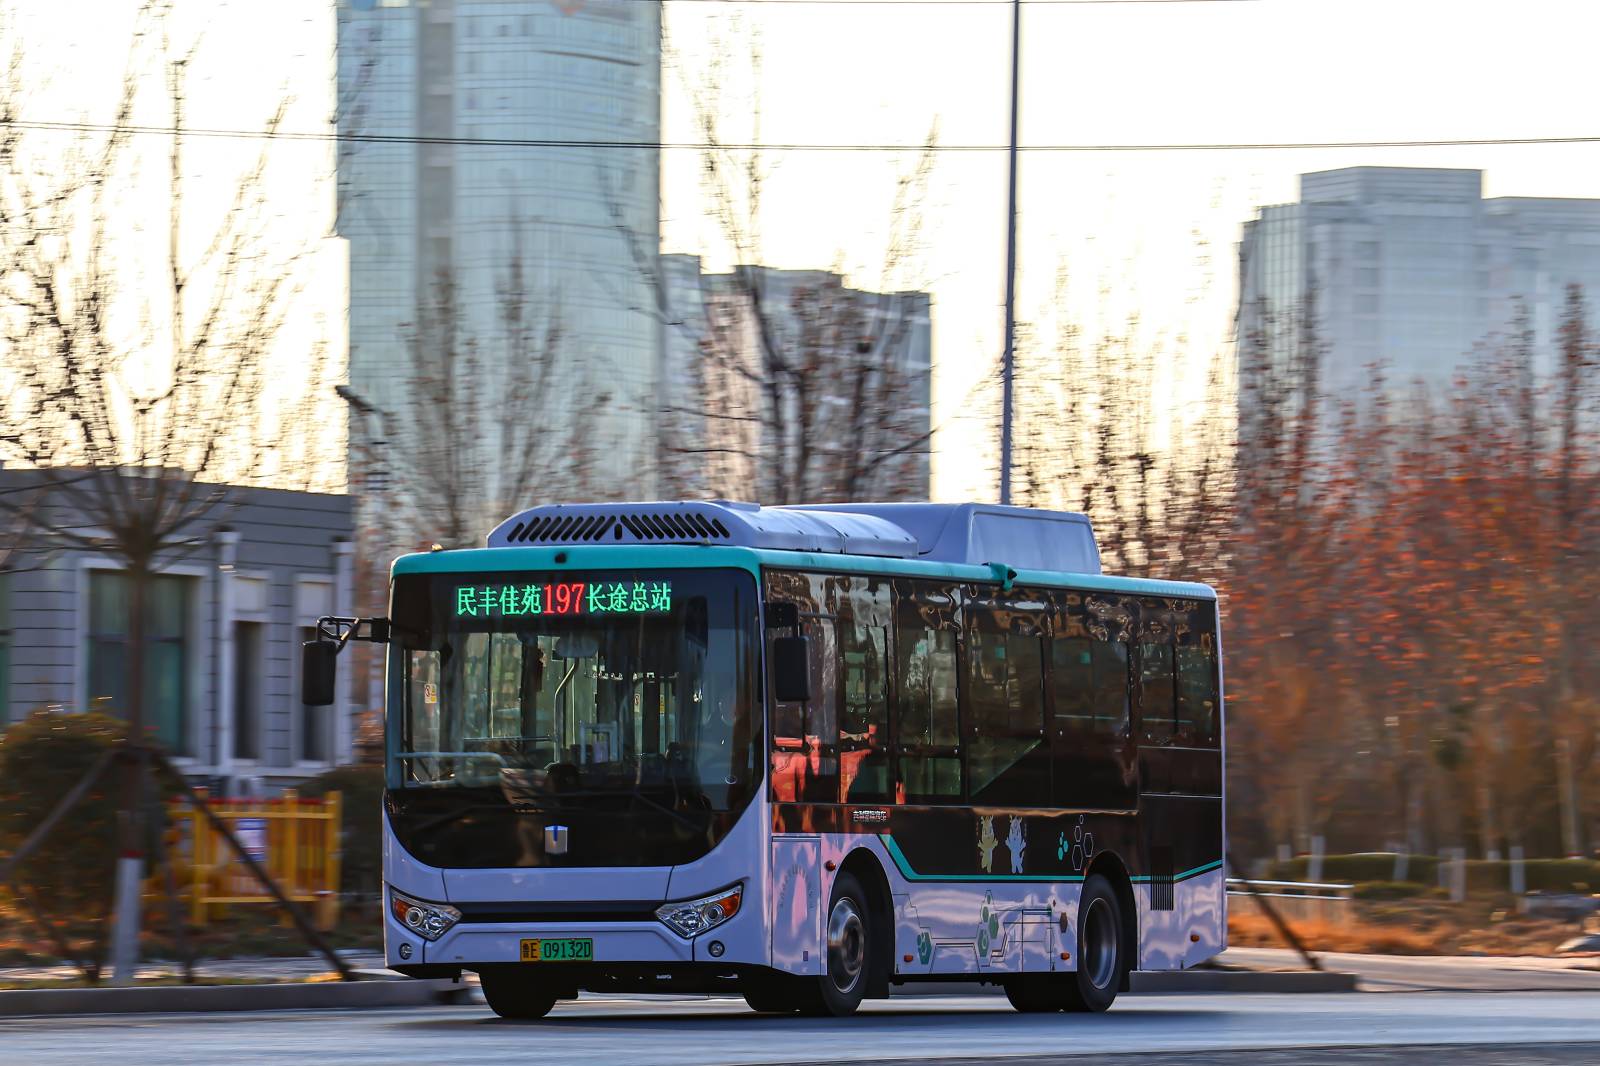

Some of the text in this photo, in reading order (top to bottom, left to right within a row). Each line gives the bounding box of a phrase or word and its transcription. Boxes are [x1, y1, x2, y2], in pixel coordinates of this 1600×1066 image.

[456, 582, 672, 616] 民丰佳苑 197 长途总站
